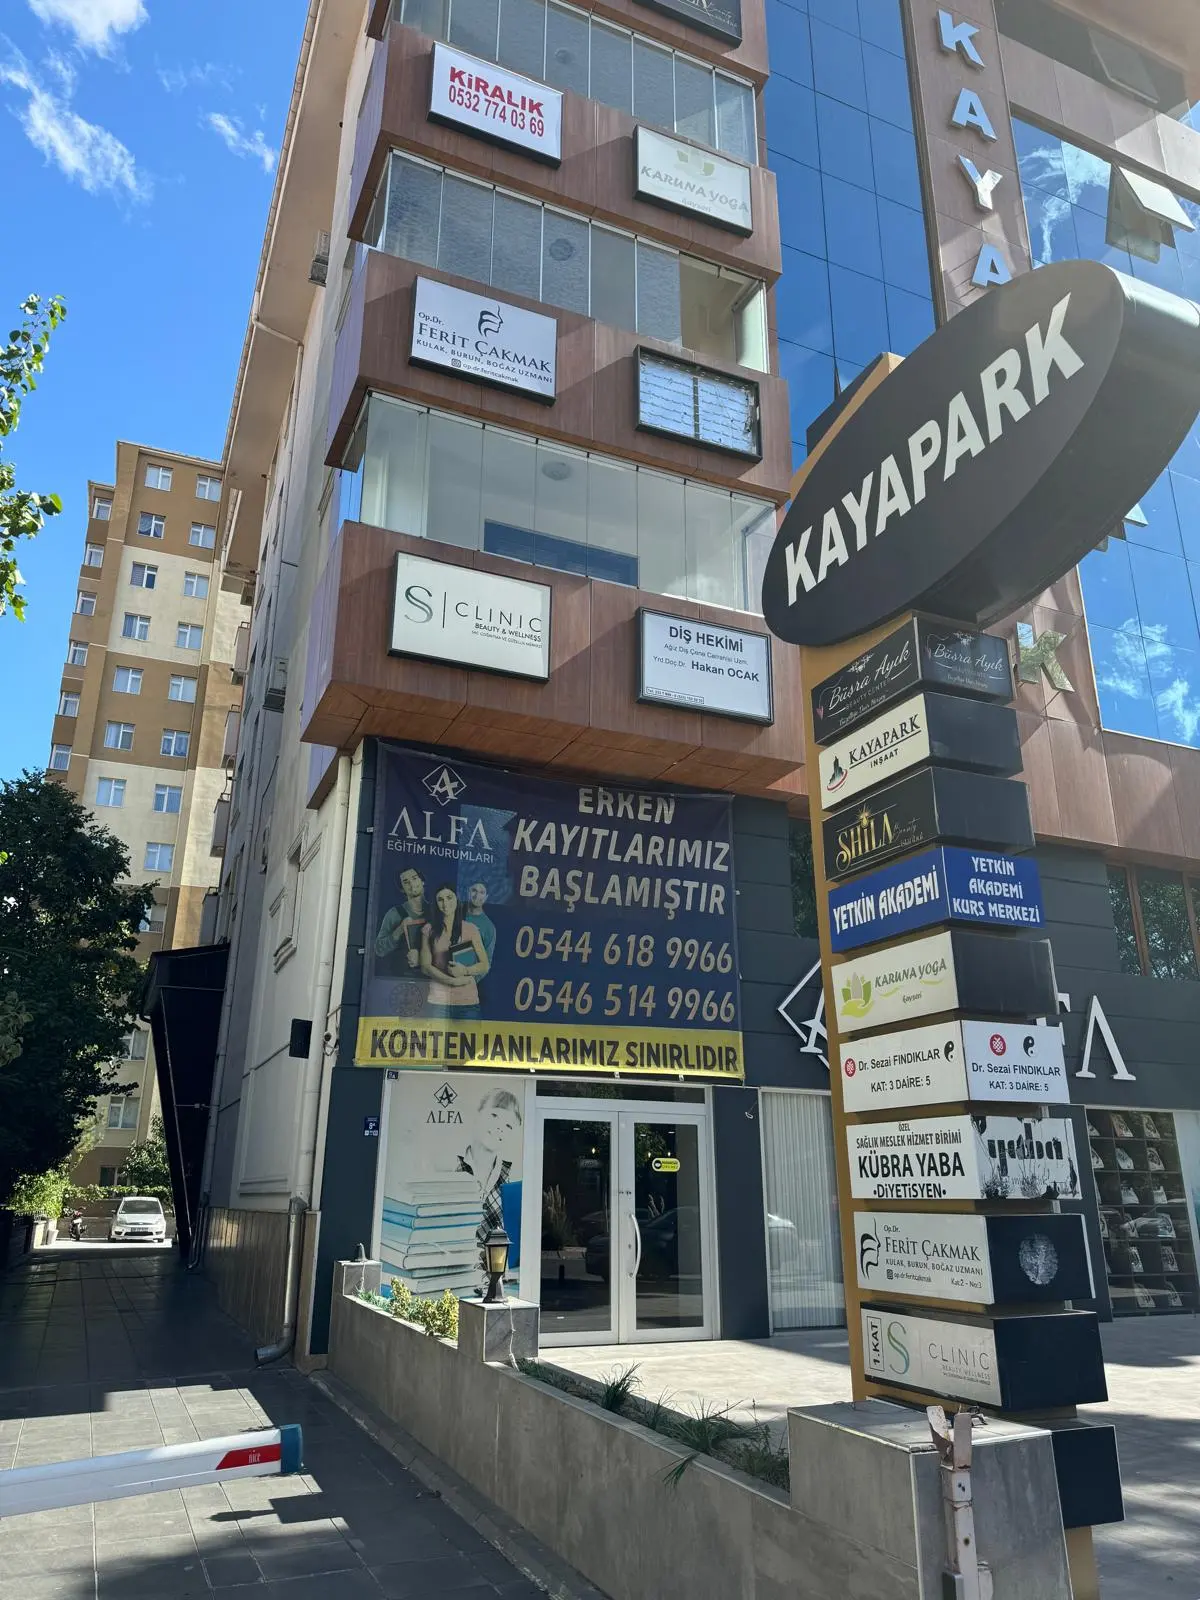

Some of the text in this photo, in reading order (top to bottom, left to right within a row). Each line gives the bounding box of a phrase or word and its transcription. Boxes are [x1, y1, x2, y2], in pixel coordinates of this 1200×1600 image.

[449, 84, 544, 137] 0532 774 03 69
[937, 9, 1012, 288] KAYA
[641, 166, 749, 213] KARUNA YOGA
[418, 311, 445, 326] Op.Dr.
[416, 339, 553, 383] KULAK, BURUN, BOĞAZ UZMANI
[418, 322, 551, 373] FERİT ÇAKMAK
[785, 292, 1085, 606] KAYAPARK
[455, 602, 542, 632] CLINIC
[474, 623, 500, 633] BEAUTY
[509, 630, 542, 642] WELLNESS
[669, 626, 743, 653] DİŞ HEKİMİ
[691, 660, 725, 676] Hakan
[727, 668, 760, 682] OCAK
[849, 713, 921, 766] KAYAPARK
[578, 787, 675, 825] ERKEN
[387, 805, 493, 851] ALFA
[387, 838, 494, 865] EĞİTİM KURUMLARI
[513, 818, 731, 873] KAYITLARIMIZ
[972, 855, 1015, 876] YETKİN
[519, 864, 726, 921] BAŞLAMIŞTIR
[833, 864, 940, 934] YETKİN AKADEMİ
[969, 879, 1023, 899] AKADEMİ
[952, 897, 1040, 923] KURS MERKEZİ
[515, 925, 734, 974] 0544 618 9966
[874, 958, 947, 988] KARUNA YOGA
[514, 977, 736, 1023] 0546 514 9966
[370, 1028, 620, 1067] KONTENJANLARIMIZ
[625, 1041, 739, 1072] SINIRLIDIR
[858, 1049, 941, 1071] Dr. Sezai FINDIKLAR
[971, 1062, 1061, 1077] Dr. Sezai FINDIKLAR
[870, 1075, 931, 1093] KAT: 3 DAİRE: 5
[989, 1079, 1049, 1092] KAT: 3 DAİRE: 5
[425, 1110, 463, 1124] ALFA
[898, 1121, 910, 1131] ÖZEL
[856, 1129, 962, 1149] SAĞLIK MESLEK HİZMET BİRİMİ
[858, 1150, 965, 1178] KÜBRA YABA
[884, 1237, 981, 1261] FERİT ÇAKMAK
[931, 1262, 954, 1273] BOĞAZ
[955, 1265, 983, 1276] UZMANI
[871, 1321, 880, 1365] 1.KAT
[928, 1342, 990, 1370] CLINIC
